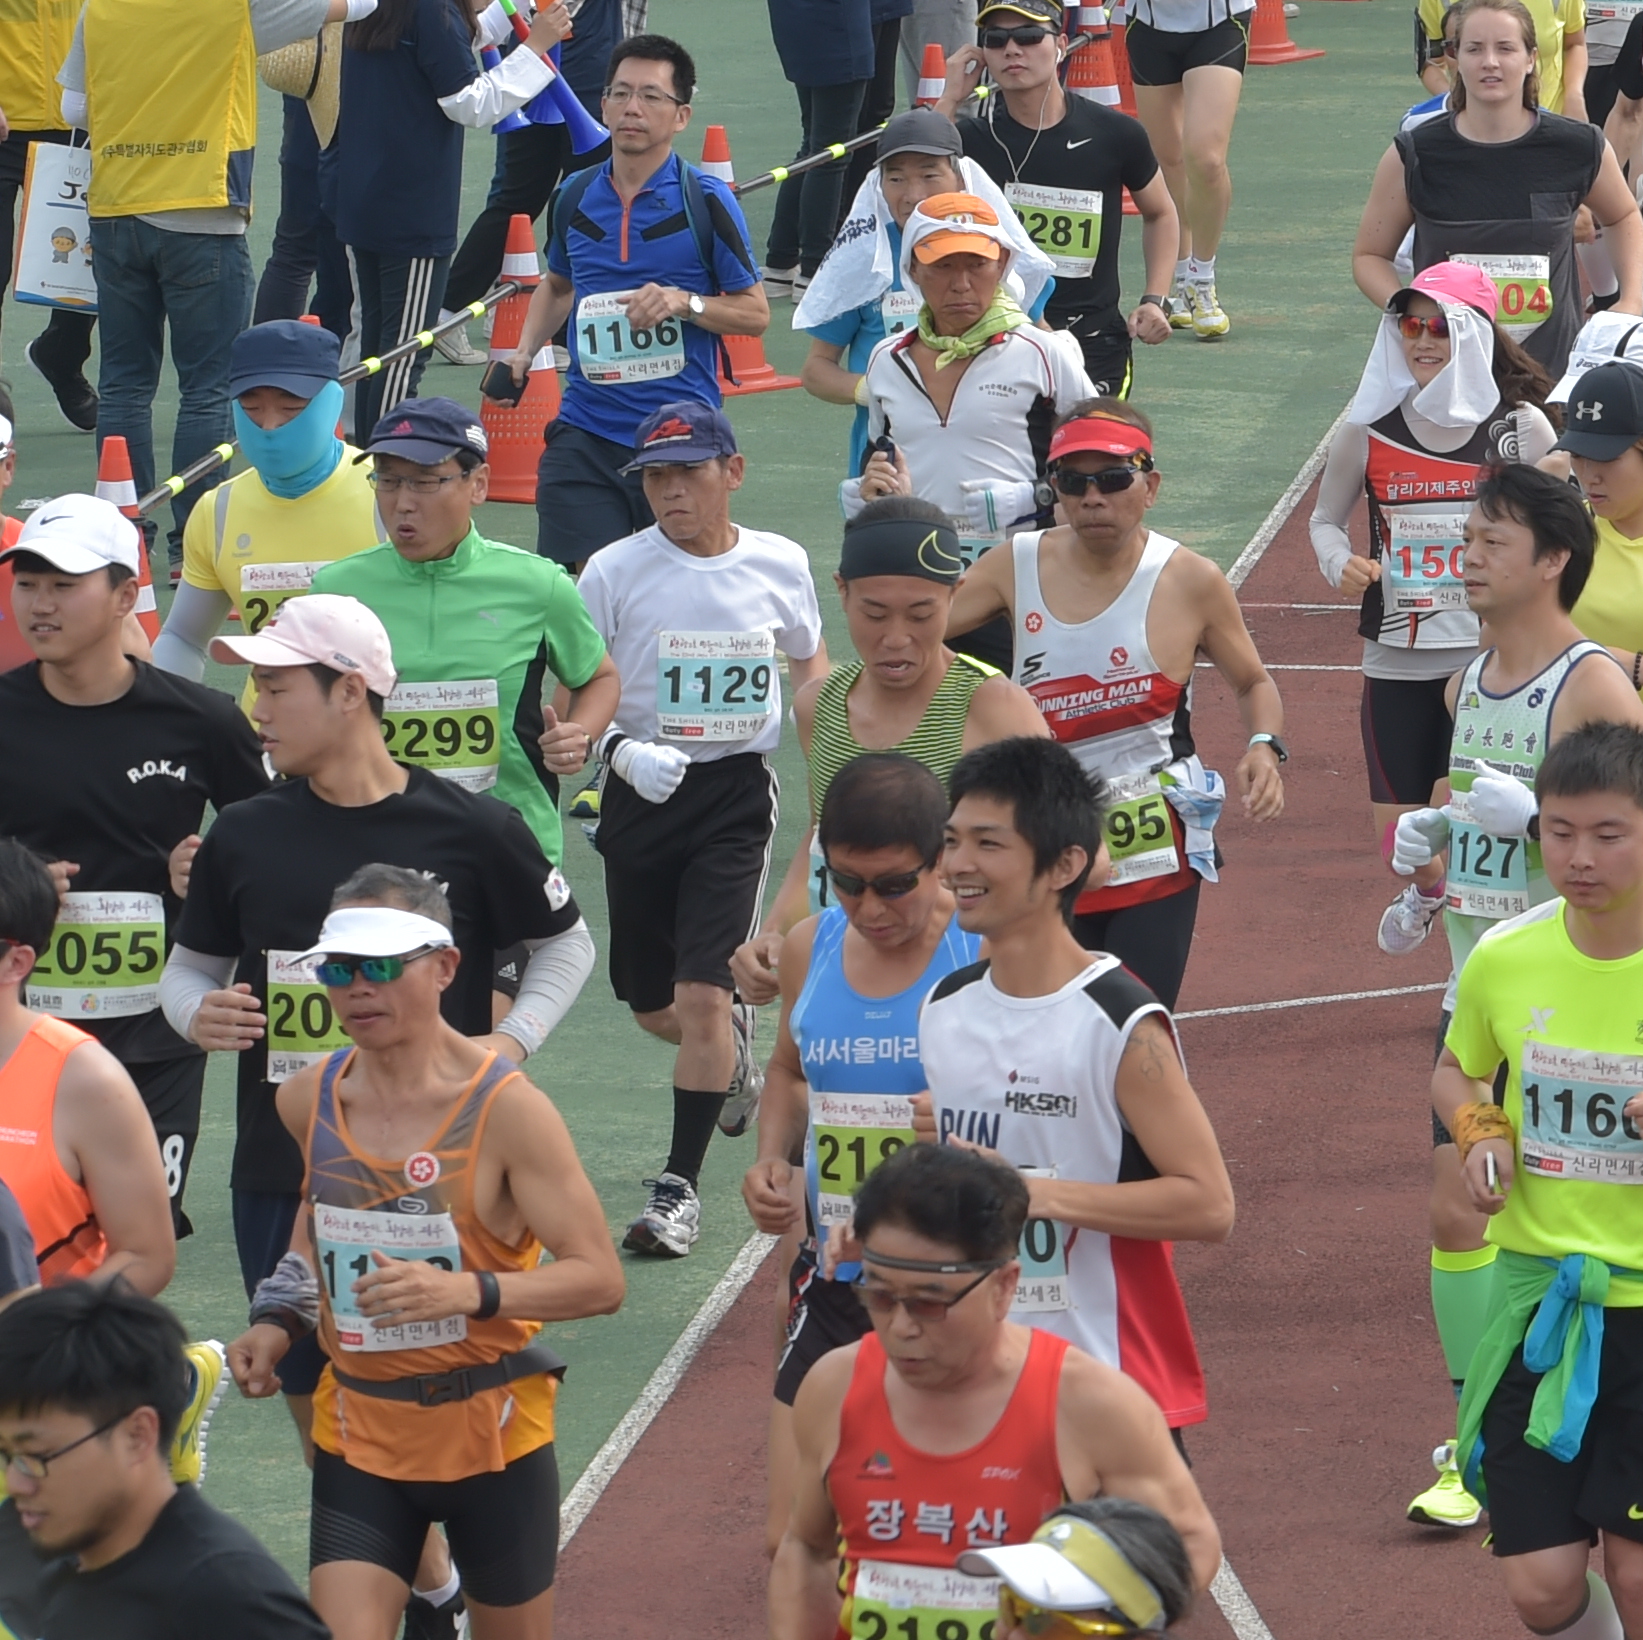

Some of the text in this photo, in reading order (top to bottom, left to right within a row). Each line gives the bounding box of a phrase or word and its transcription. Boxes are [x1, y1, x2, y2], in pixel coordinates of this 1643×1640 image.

[581, 316, 681, 355] 1166
[627, 360, 681, 376] 신라면세점
[664, 663, 769, 704] 1129
[1108, 678, 1152, 698] MAN
[1065, 696, 1136, 719] Athletic Club
[384, 716, 494, 760] 2299
[1467, 893, 1526, 911] 신라면세점
[866, 1499, 1007, 1545] 장복산
